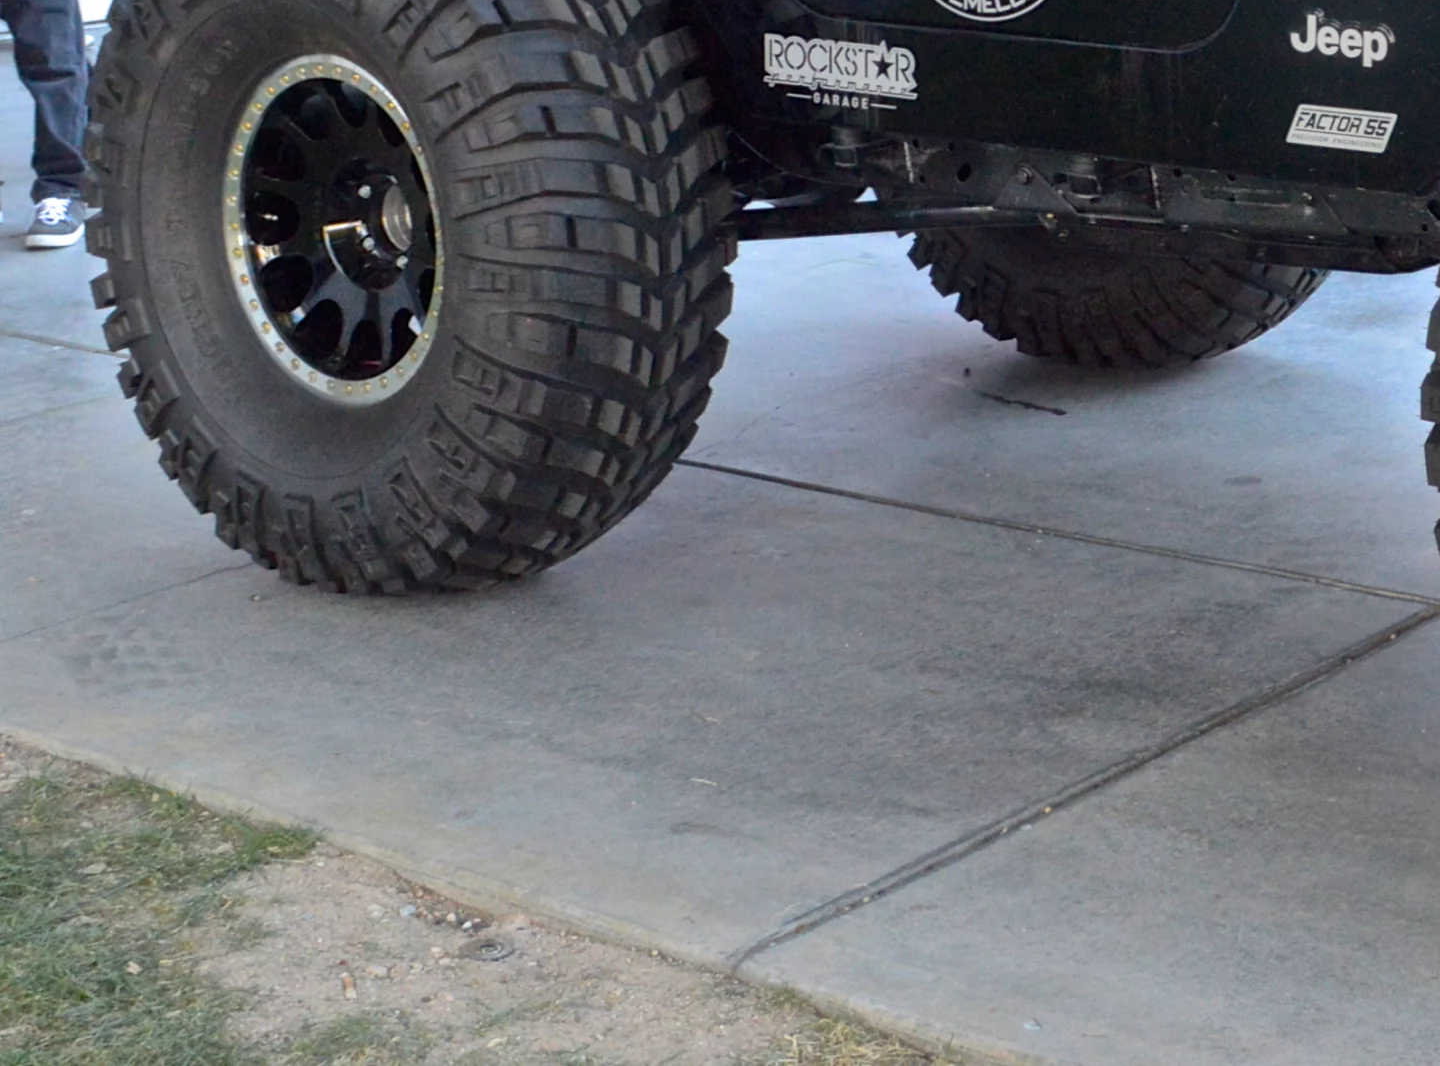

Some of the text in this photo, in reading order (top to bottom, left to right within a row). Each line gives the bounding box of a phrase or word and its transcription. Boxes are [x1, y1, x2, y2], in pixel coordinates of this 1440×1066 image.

[1290, 13, 1389, 68] Jeep
[812, 92, 870, 110] GARAGE
[1295, 112, 1391, 137] FACTOR 55
